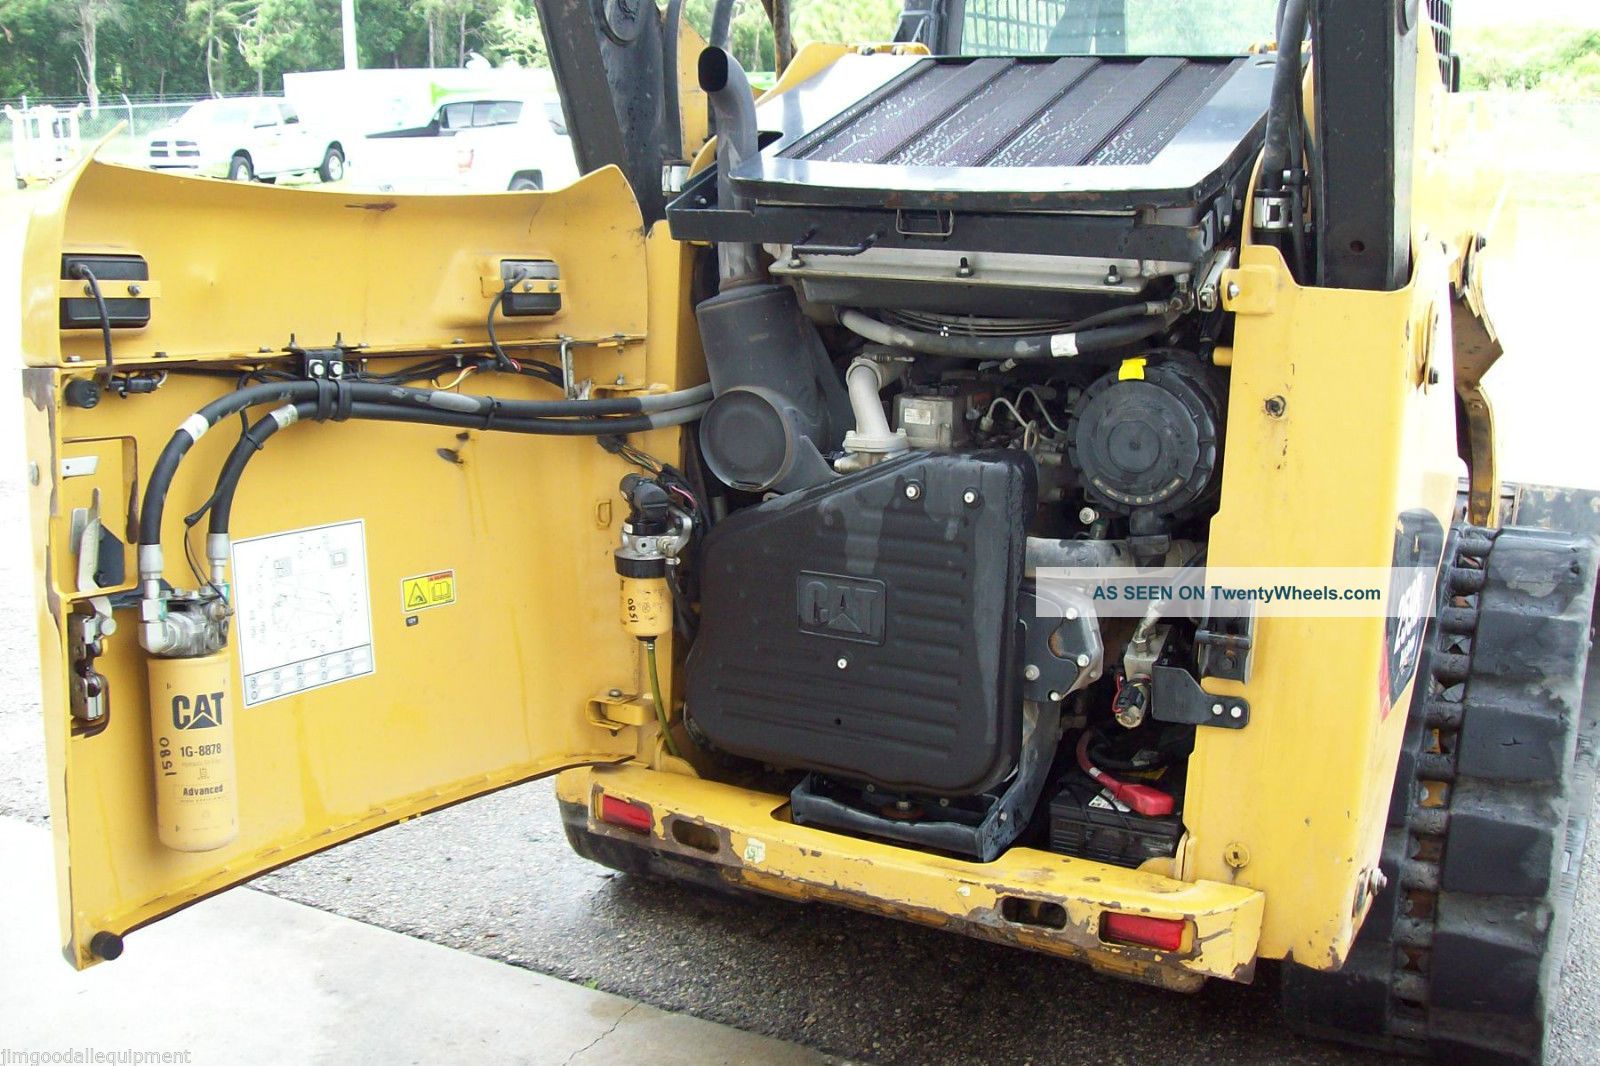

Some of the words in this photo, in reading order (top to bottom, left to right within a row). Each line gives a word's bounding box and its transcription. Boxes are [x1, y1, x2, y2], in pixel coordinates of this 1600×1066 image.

[801, 581, 878, 635] CAT
[172, 692, 224, 729] CAT
[159, 737, 177, 776] 1580
[180, 743, 222, 758] 1G-8878
[183, 784, 223, 796] Advanced
